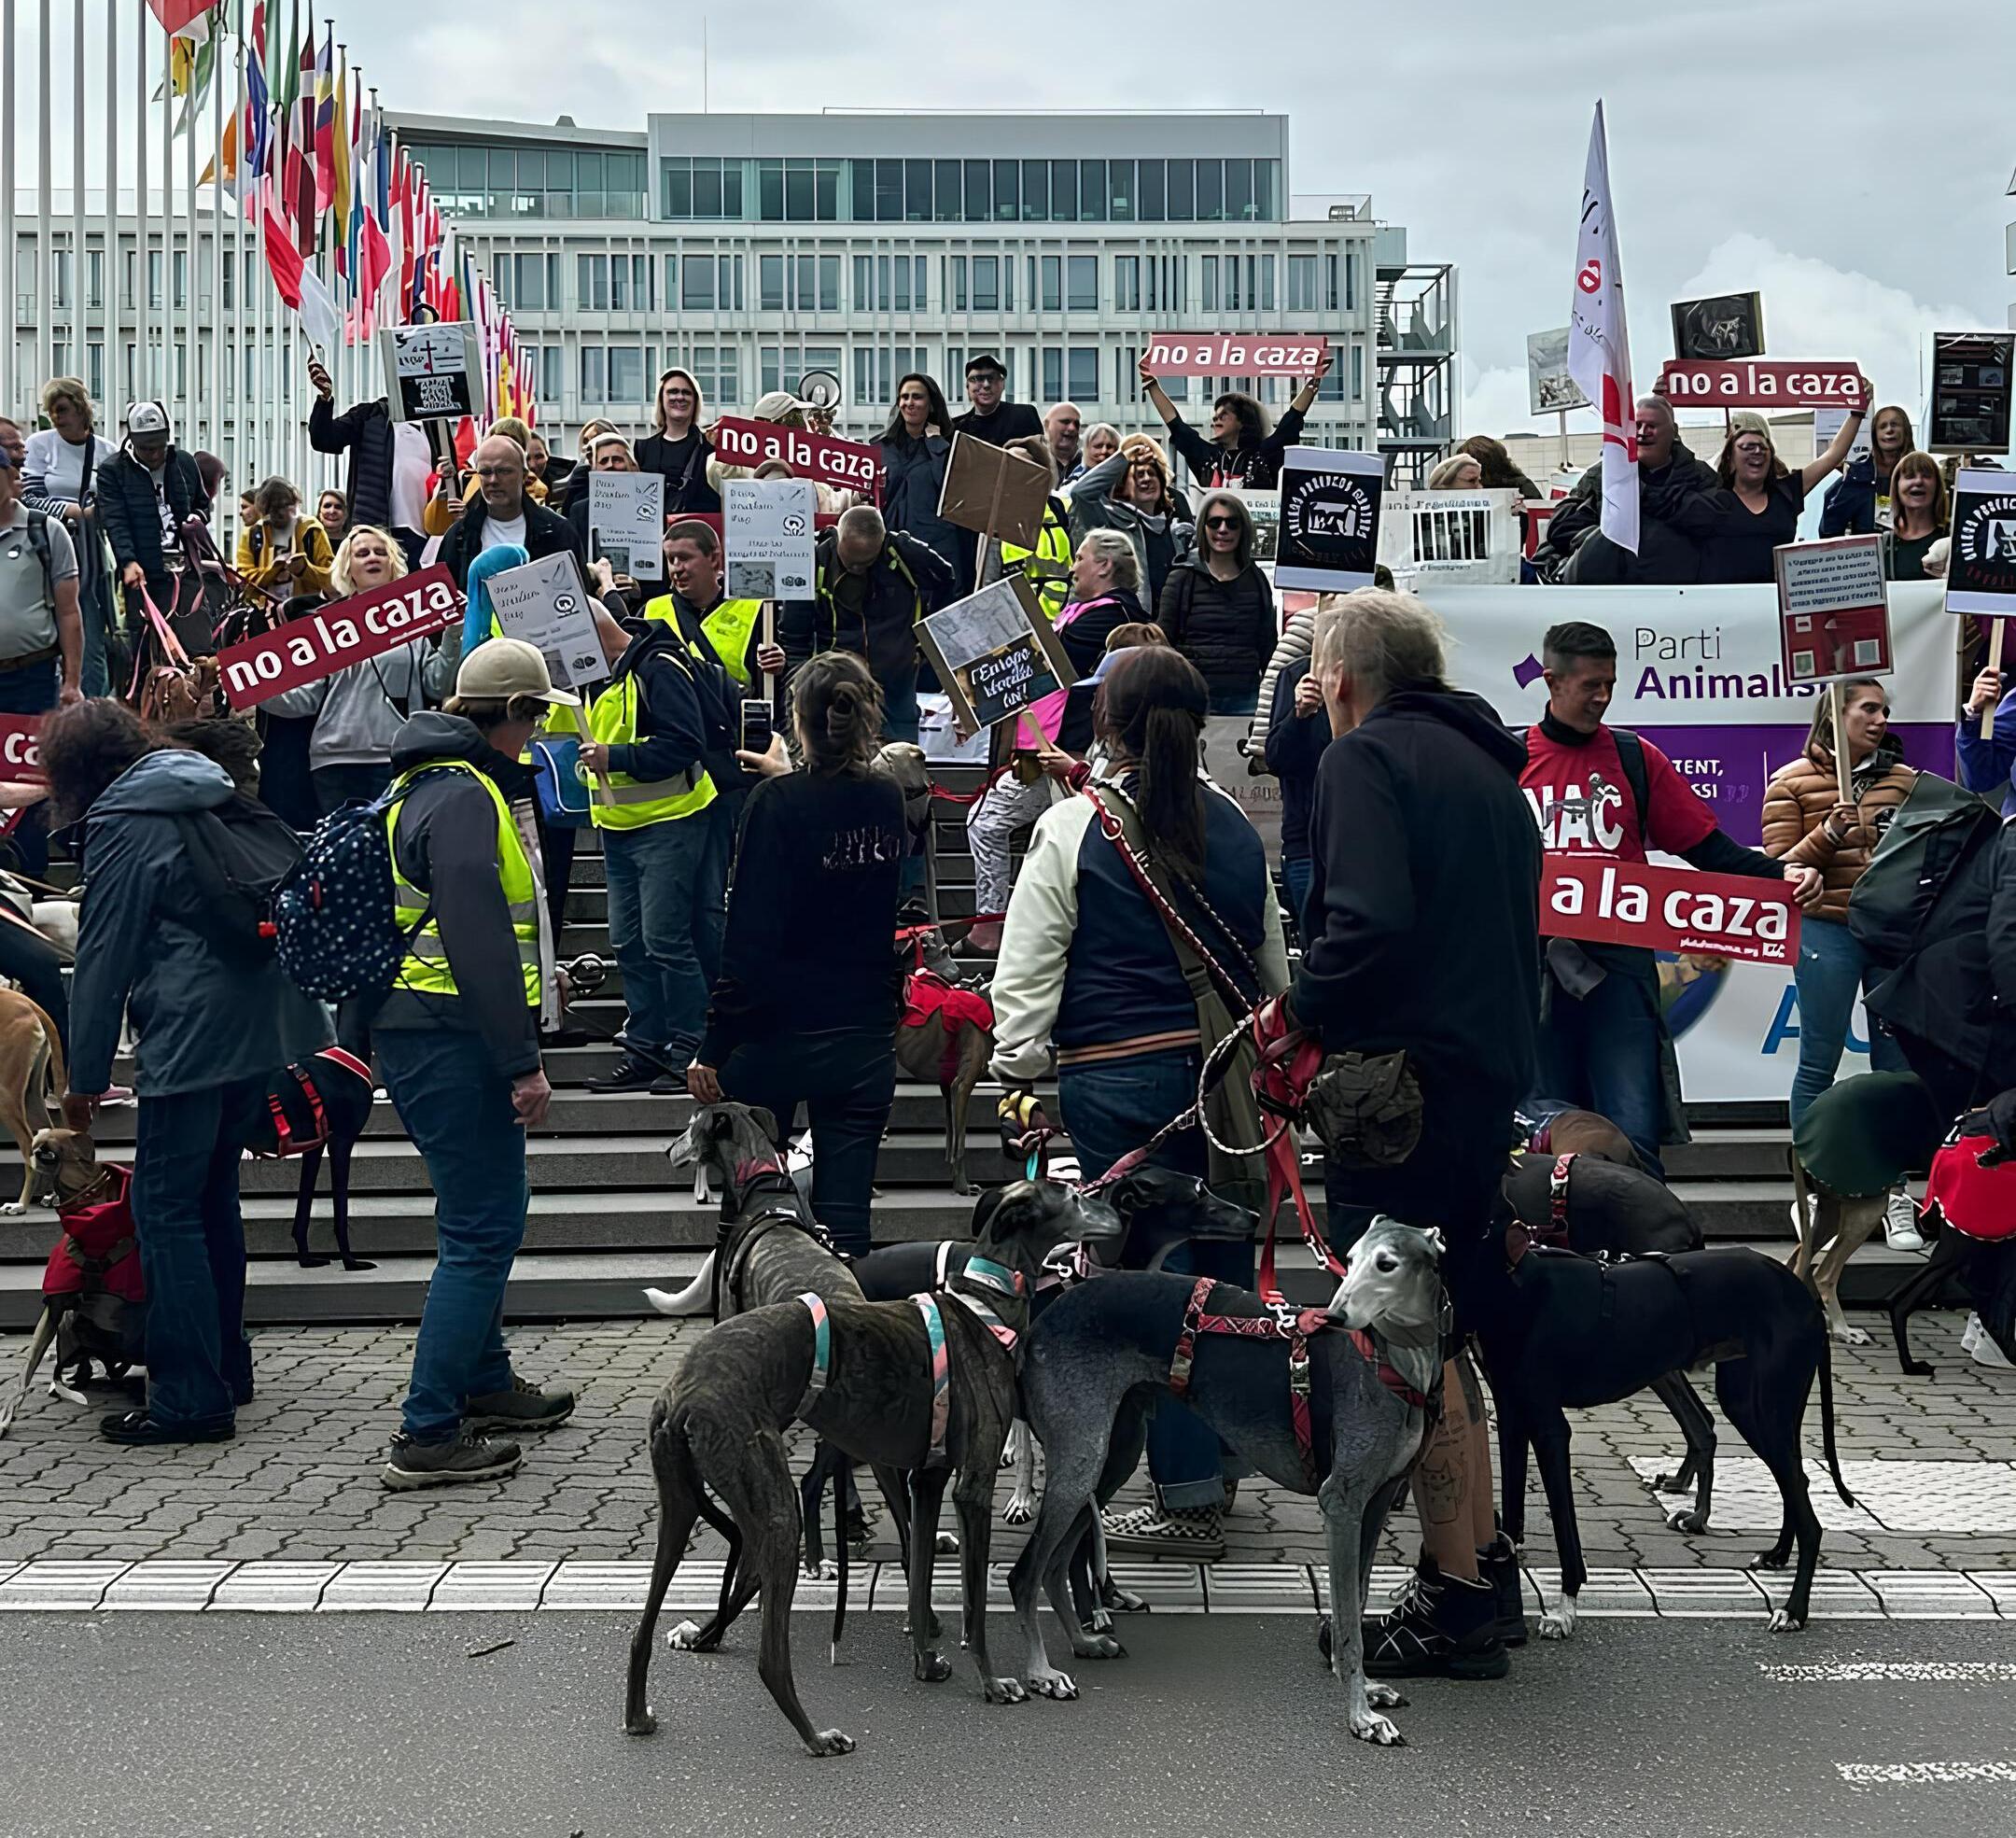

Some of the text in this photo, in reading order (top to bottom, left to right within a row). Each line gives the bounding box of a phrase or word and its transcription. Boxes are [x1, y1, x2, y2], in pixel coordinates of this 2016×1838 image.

[1151, 339, 1321, 366] no a la caza
[1669, 364, 1860, 395] no a la caza
[721, 428, 875, 480] no a la caza
[227, 651, 283, 693] no
[287, 637, 316, 666] a
[313, 615, 360, 654] la
[364, 581, 455, 635] caza
[1635, 626, 1720, 660] Parti
[1634, 664, 1827, 700] Animals
[5, 733, 39, 765] ca
[1672, 759, 1724, 777] TENT,
[1691, 783, 1717, 798] SSI
[1551, 867, 1788, 940] a la caza
